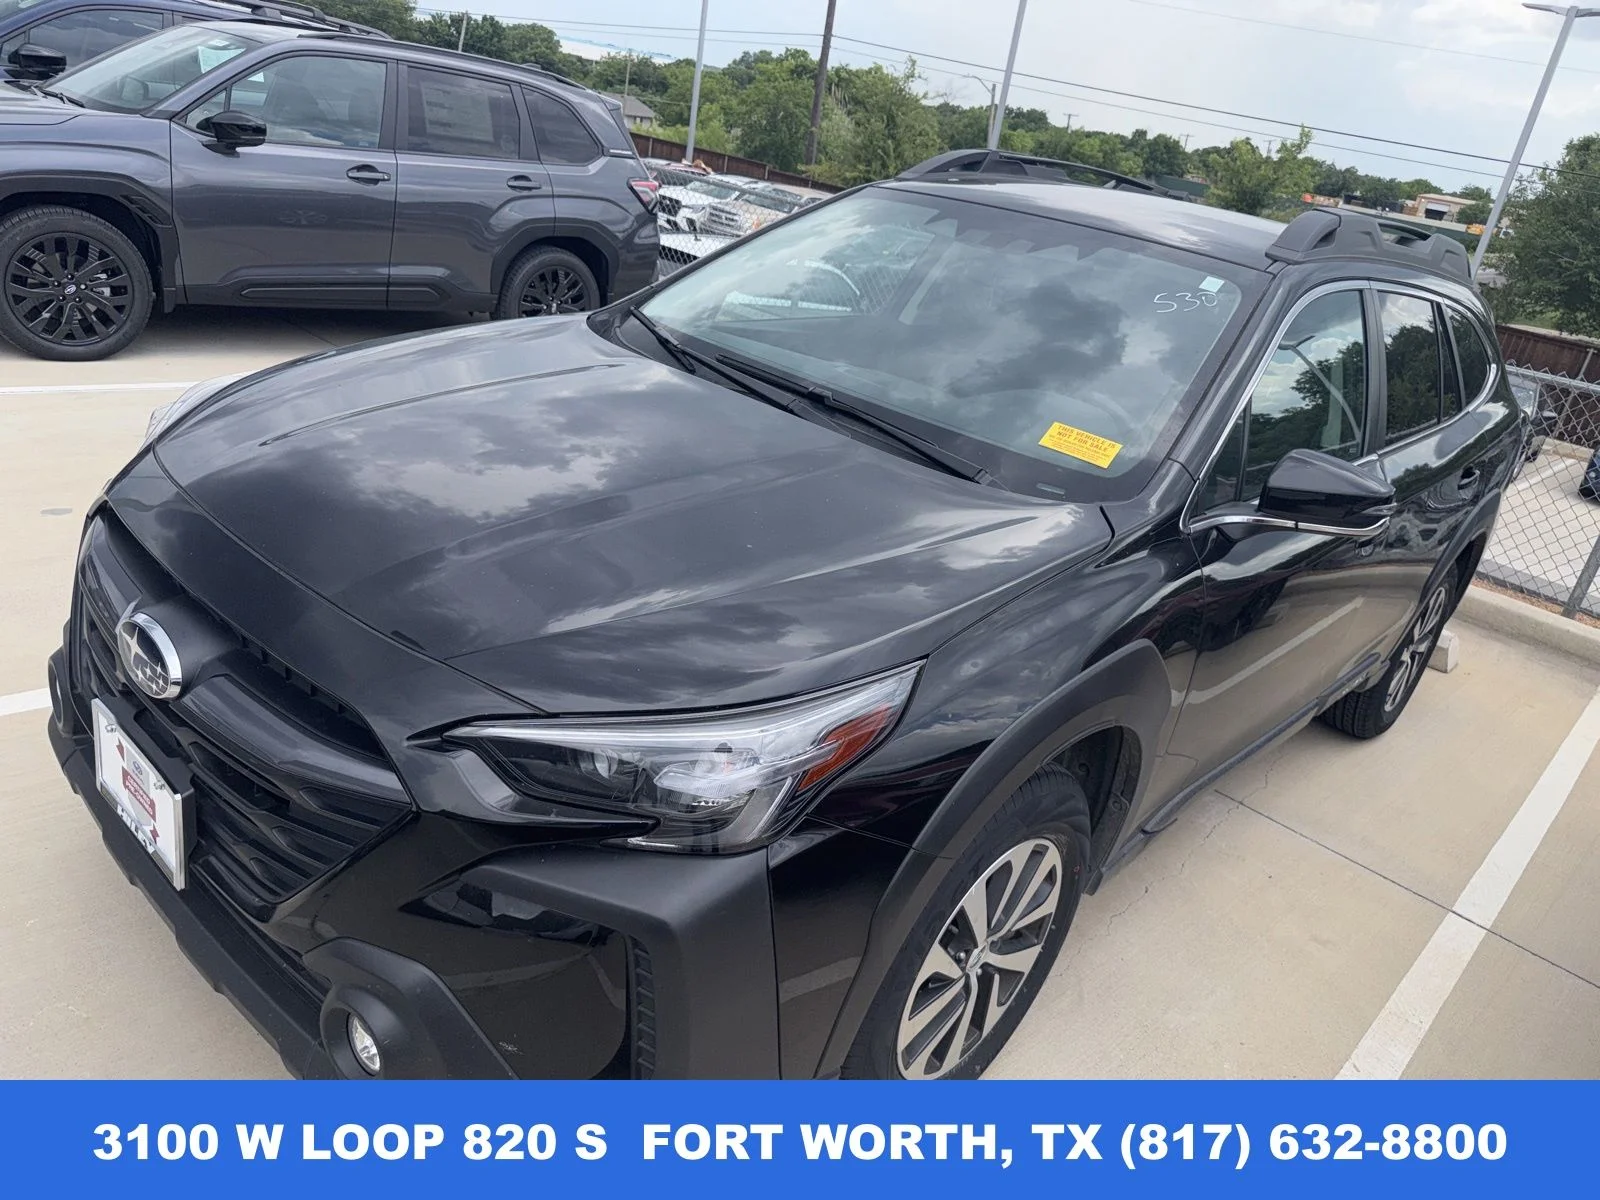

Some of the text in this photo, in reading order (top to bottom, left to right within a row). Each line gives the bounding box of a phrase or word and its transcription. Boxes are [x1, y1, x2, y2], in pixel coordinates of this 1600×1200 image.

[1056, 431, 1109, 452] NOT FOR SALE
[1057, 425, 1116, 449] THIS VEHICLE IS
[116, 803, 156, 854] HILEY
